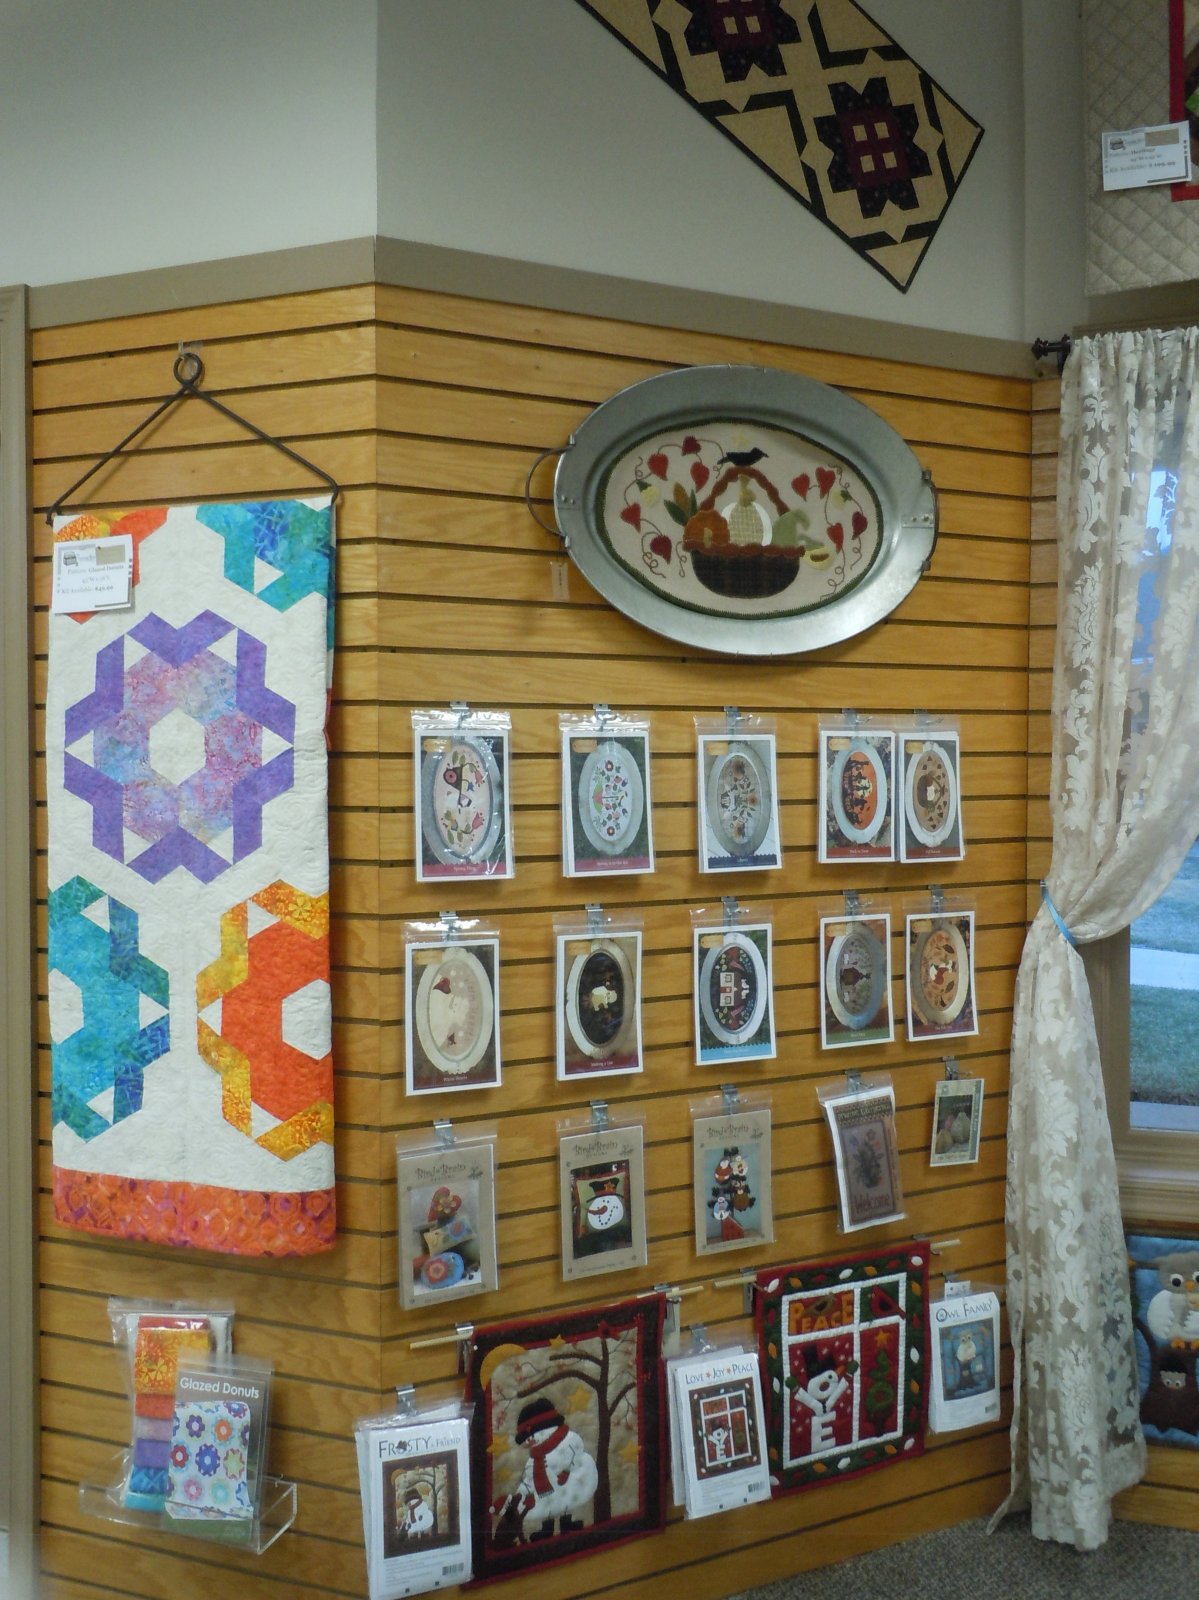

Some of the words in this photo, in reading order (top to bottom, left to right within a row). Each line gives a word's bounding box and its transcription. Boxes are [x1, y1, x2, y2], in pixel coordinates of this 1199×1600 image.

[935, 1307, 961, 1322] OWL
[962, 1298, 993, 1318] FAMILY
[685, 1373, 704, 1385] LOVE
[713, 1367, 725, 1379] JOY
[731, 1363, 754, 1375] PEACE
[179, 1377, 220, 1393] Glazed
[222, 1382, 260, 1399] Donuts
